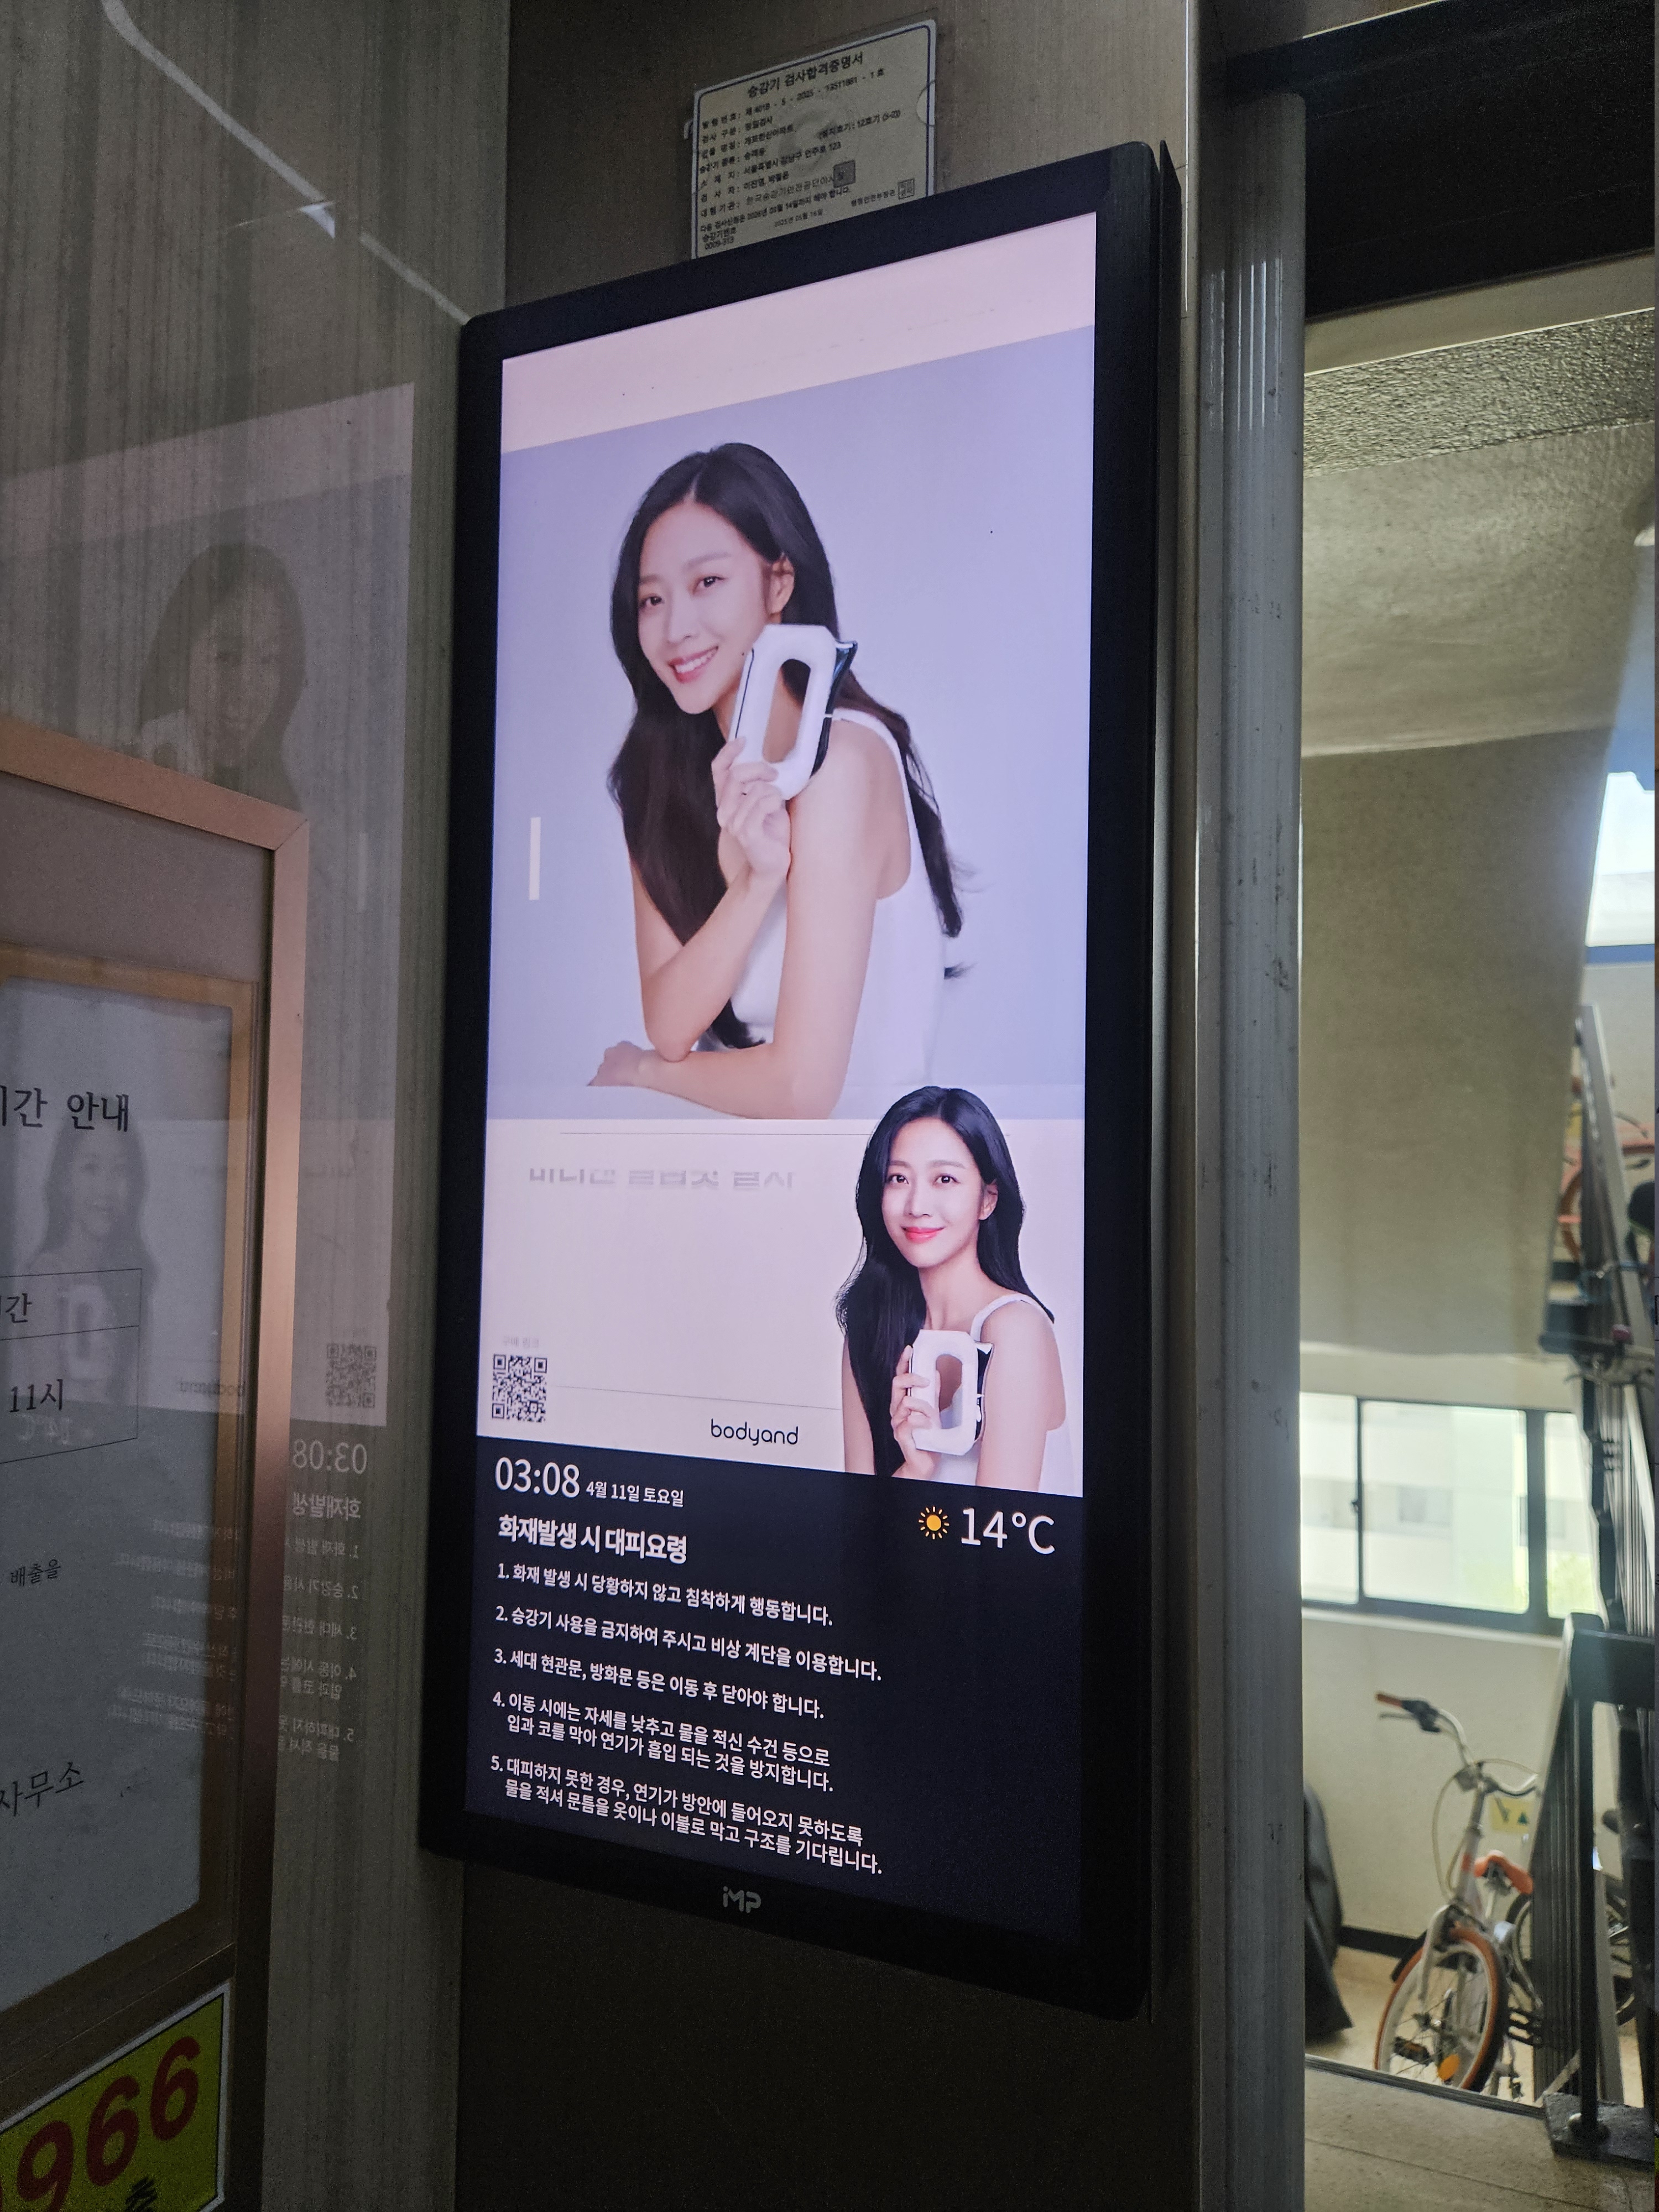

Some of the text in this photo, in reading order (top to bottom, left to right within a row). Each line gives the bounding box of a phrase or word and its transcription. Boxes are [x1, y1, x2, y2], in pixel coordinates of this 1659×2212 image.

[747, 51, 863, 99] 승강기 검사합격증명서
[743, 158, 778, 176] 서울특별시
[67, 1092, 129, 1132] 안내
[9, 1379, 64, 1412] 11시
[711, 1418, 798, 1446] bodyand
[495, 1457, 684, 1507] 03:08 4월 11일 토요일
[498, 1514, 687, 1564] 화재발생 시 대피요령
[10, 1559, 61, 1586] 배출을
[497, 1563, 832, 1626] 1. 화재 발생 시 당황하지 않고 침착하게 행동합니다.
[495, 1605, 881, 1681] 2. 승강기 사용을 금지하여 주시고 비상 계단을 이용합니다.
[494, 1648, 824, 1719] 3. 세대 현관문, 방화문 등은 이동 후 닫아야 합니다.
[492, 1691, 831, 1767] 4. 이동 시에는 자세를 낮추고 물을 적신 수건 등으로
[507, 1714, 833, 1792] 입과 코를 막아 연기가 흡입 되는 것을 방지합니다.
[491, 1755, 863, 1847] 5. 대피하지 못한 경우, 연기가 방안에 들어오지 못하도록
[505, 1778, 882, 1874] 물을 적셔 문틈을 옷이나 이불로 막고 구조를 기다립니다.
